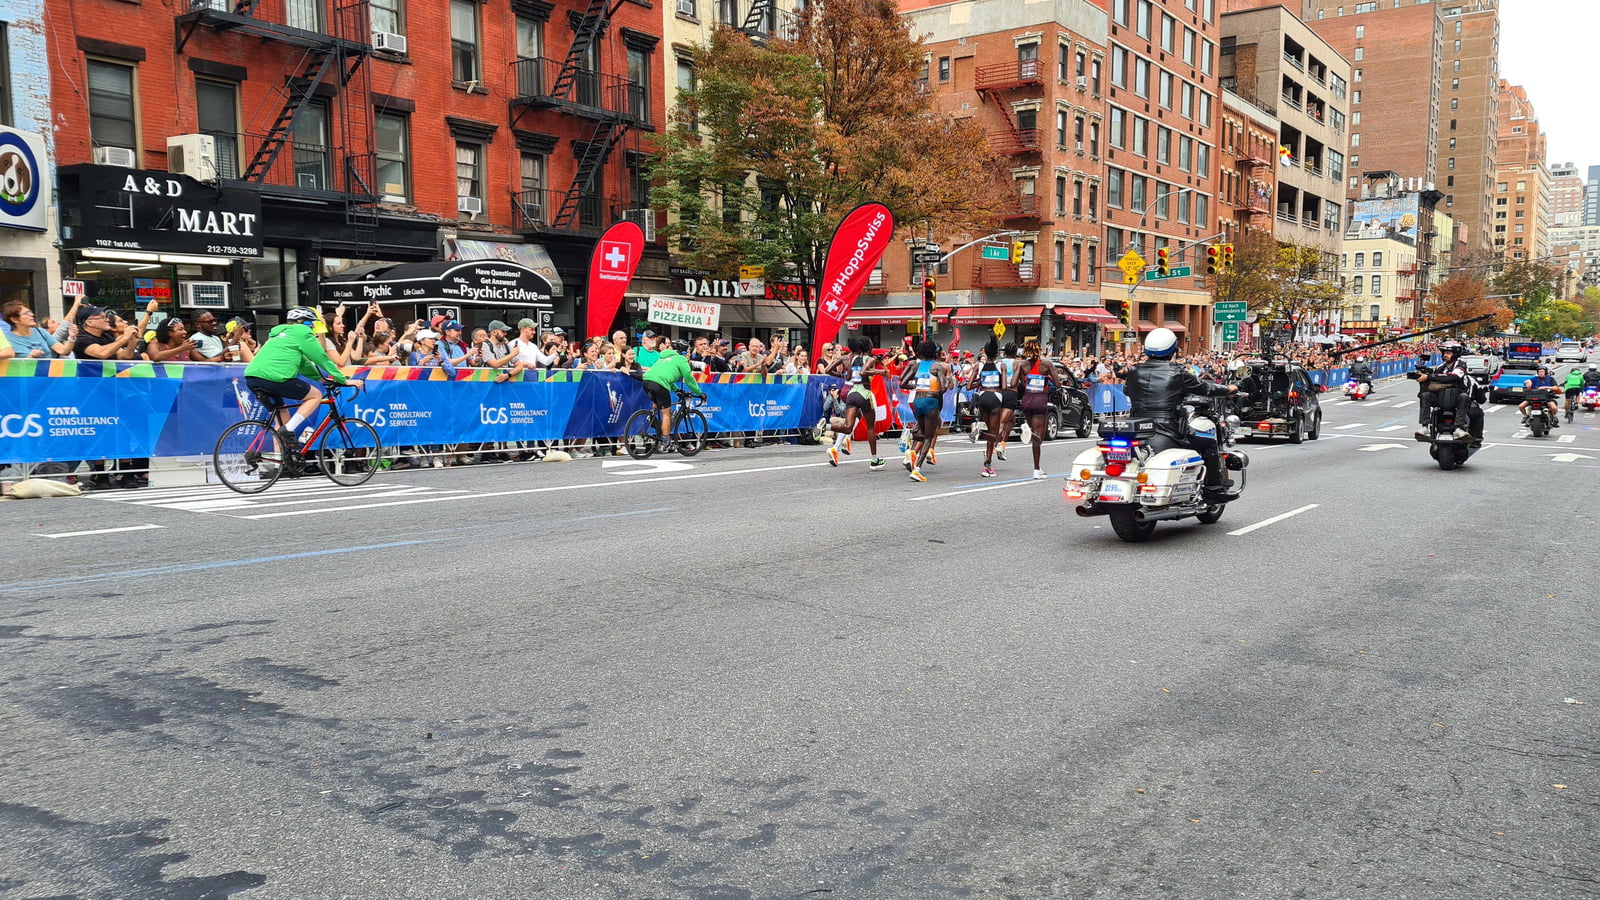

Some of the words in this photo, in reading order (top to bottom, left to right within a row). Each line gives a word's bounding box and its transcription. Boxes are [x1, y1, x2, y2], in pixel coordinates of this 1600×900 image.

[122, 174, 140, 193] A
[144, 177, 160, 196] &
[166, 180, 182, 197] D
[177, 208, 256, 236] MART
[96, 239, 112, 247] 1107
[207, 246, 258, 255] 212-759-3298
[831, 211, 886, 295] #HoppSwiss
[65, 282, 83, 294] ATM
[363, 285, 392, 299] Psychic
[442, 284, 550, 300] www.Psychic1stAve.com
[684, 278, 740, 298] DAILY
[653, 300, 674, 309] JOHN
[678, 303, 683, 311] &
[686, 303, 715, 315] TONY'S
[653, 310, 702, 325] PIZZERIA
[47, 407, 80, 415] TATA
[354, 404, 386, 428] tcs
[480, 403, 508, 424] tcs
[749, 400, 766, 417] tcs
[48, 416, 119, 426] CONSULTANCY
[49, 427, 96, 436] SERVICES
